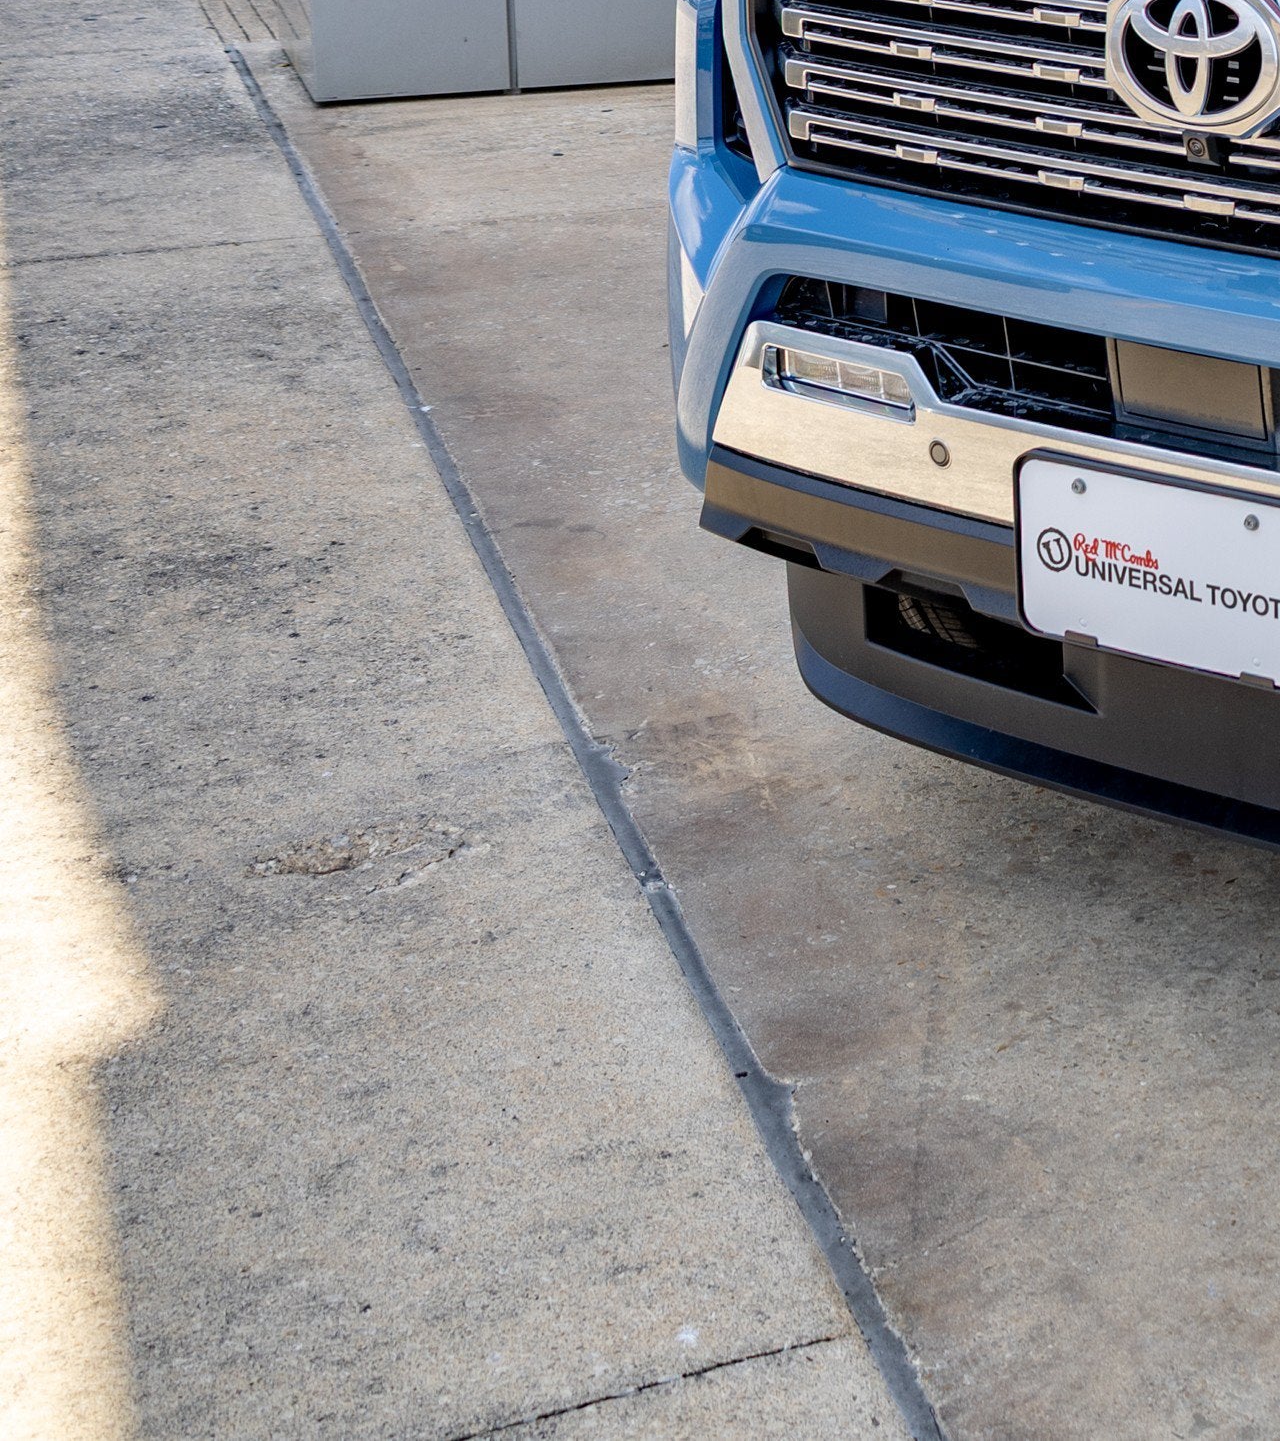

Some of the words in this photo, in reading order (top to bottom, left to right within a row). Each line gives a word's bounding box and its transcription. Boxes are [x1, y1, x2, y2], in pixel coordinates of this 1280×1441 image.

[1073, 533, 1100, 563] Red
[1101, 539, 1159, 570] McCombs
[1075, 555, 1203, 603] UNIVERSAL
